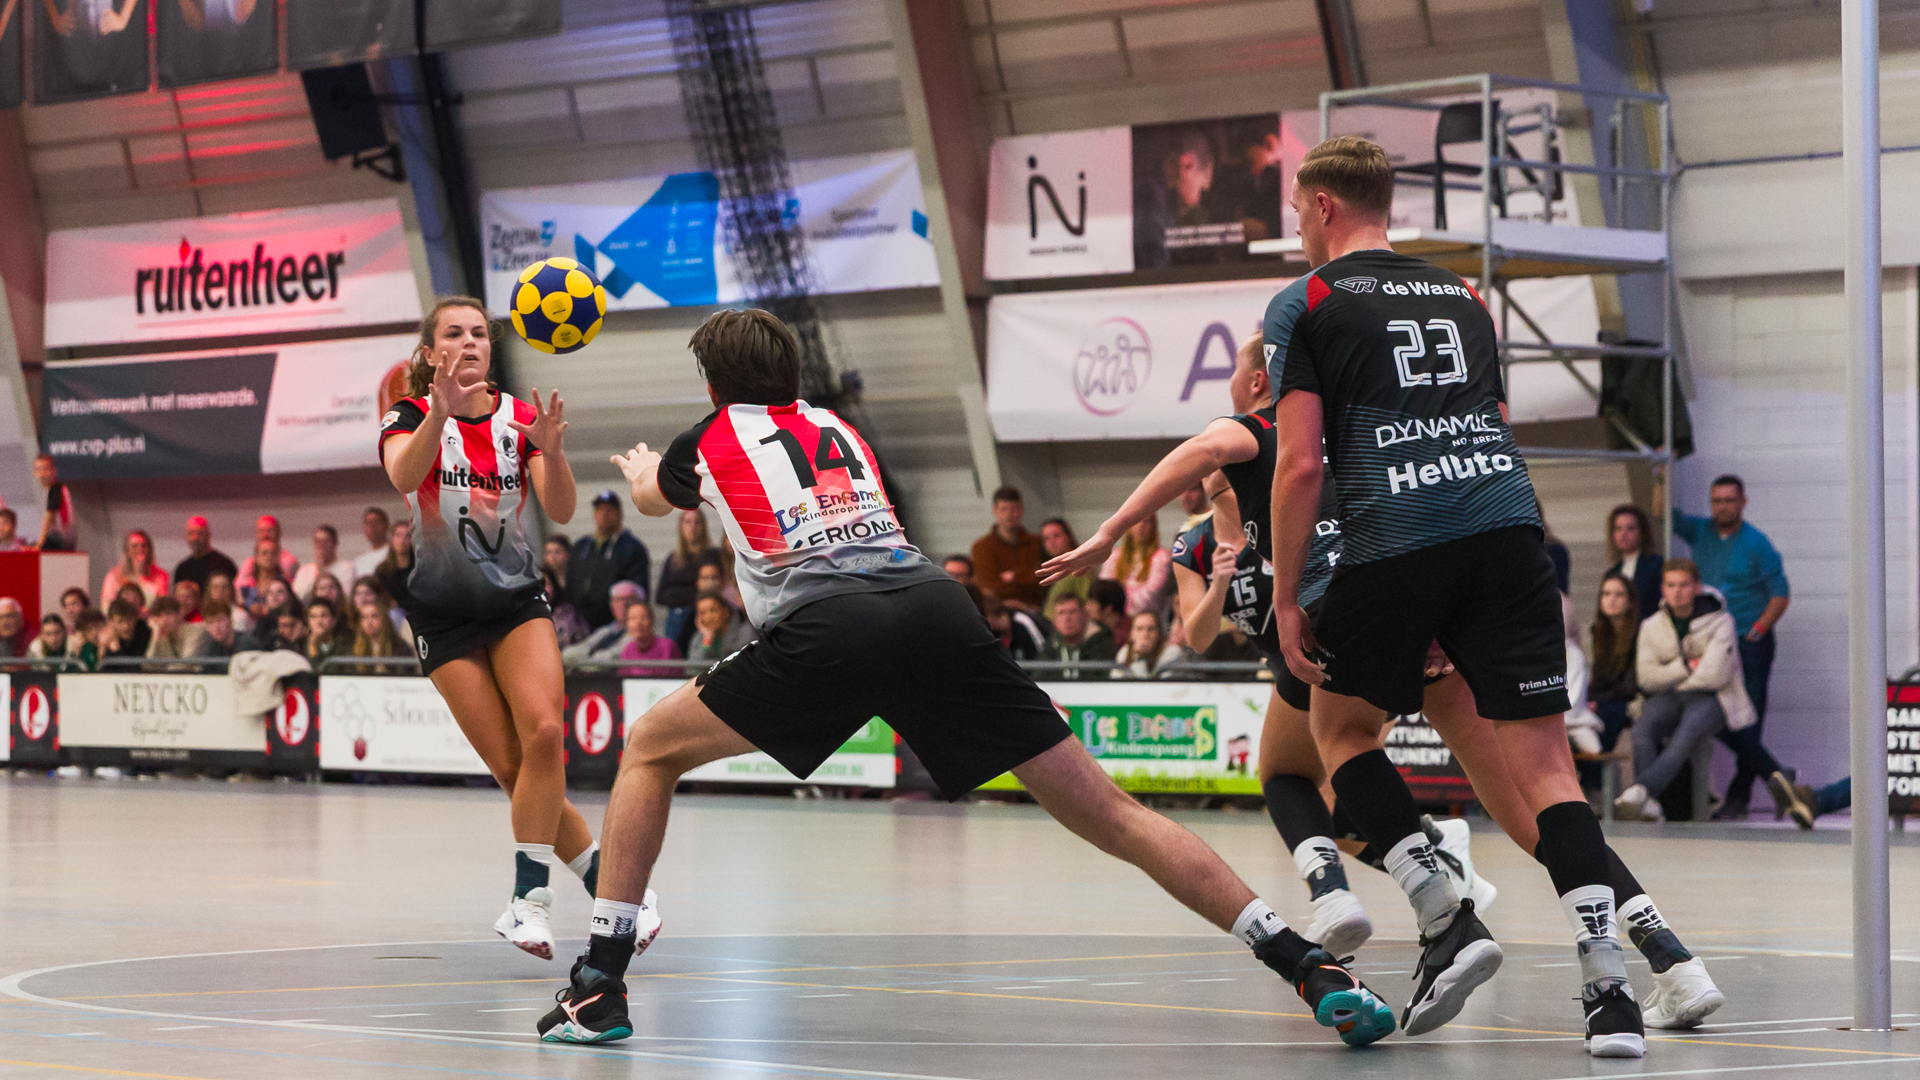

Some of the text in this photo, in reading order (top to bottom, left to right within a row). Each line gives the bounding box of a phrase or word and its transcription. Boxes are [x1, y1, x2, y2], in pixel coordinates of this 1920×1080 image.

[136, 237, 344, 314] ruitenheer
[1386, 318, 1468, 388] 23
[1375, 413, 1501, 448] DYNAMIC
[759, 426, 866, 489] 14
[1387, 451, 1513, 495] Helluto
[434, 464, 522, 491] ruitenhee
[774, 502, 808, 535] Les
[1231, 576, 1258, 607] 15
[113, 682, 208, 715] NEYCKO
[1519, 679, 1547, 691] Prima
[1548, 675, 1564, 686] Life
[1082, 710, 1119, 755] Les
